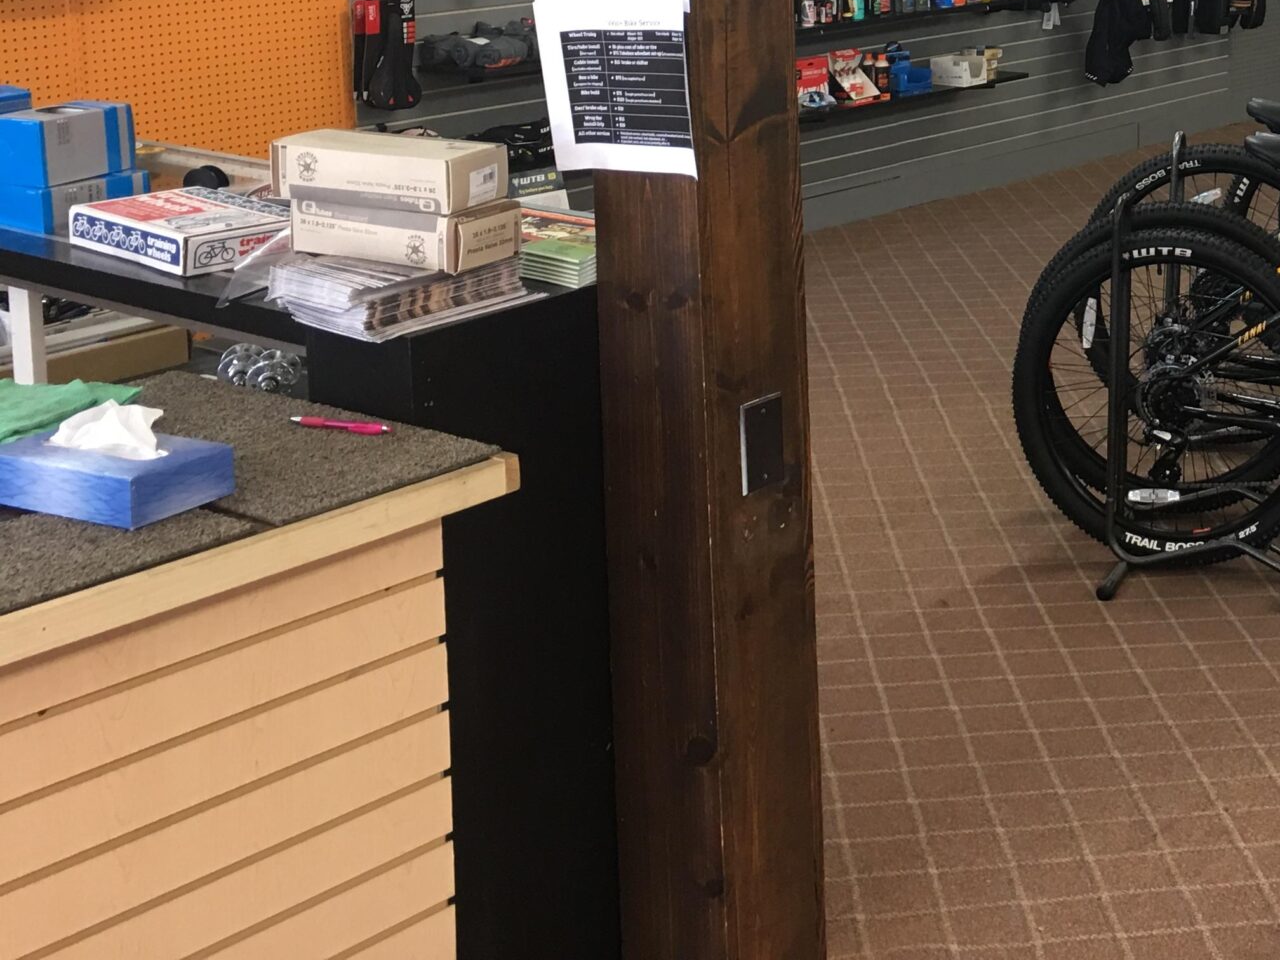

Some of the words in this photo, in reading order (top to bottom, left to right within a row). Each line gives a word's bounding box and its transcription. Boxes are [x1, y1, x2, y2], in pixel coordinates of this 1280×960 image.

[520, 174, 545, 184] WTB
[1135, 169, 1167, 191] BOSS
[147, 235, 176, 254] training
[147, 248, 171, 262] wheels
[1132, 247, 1192, 259] WTB
[1125, 531, 1161, 551] TRAIL
